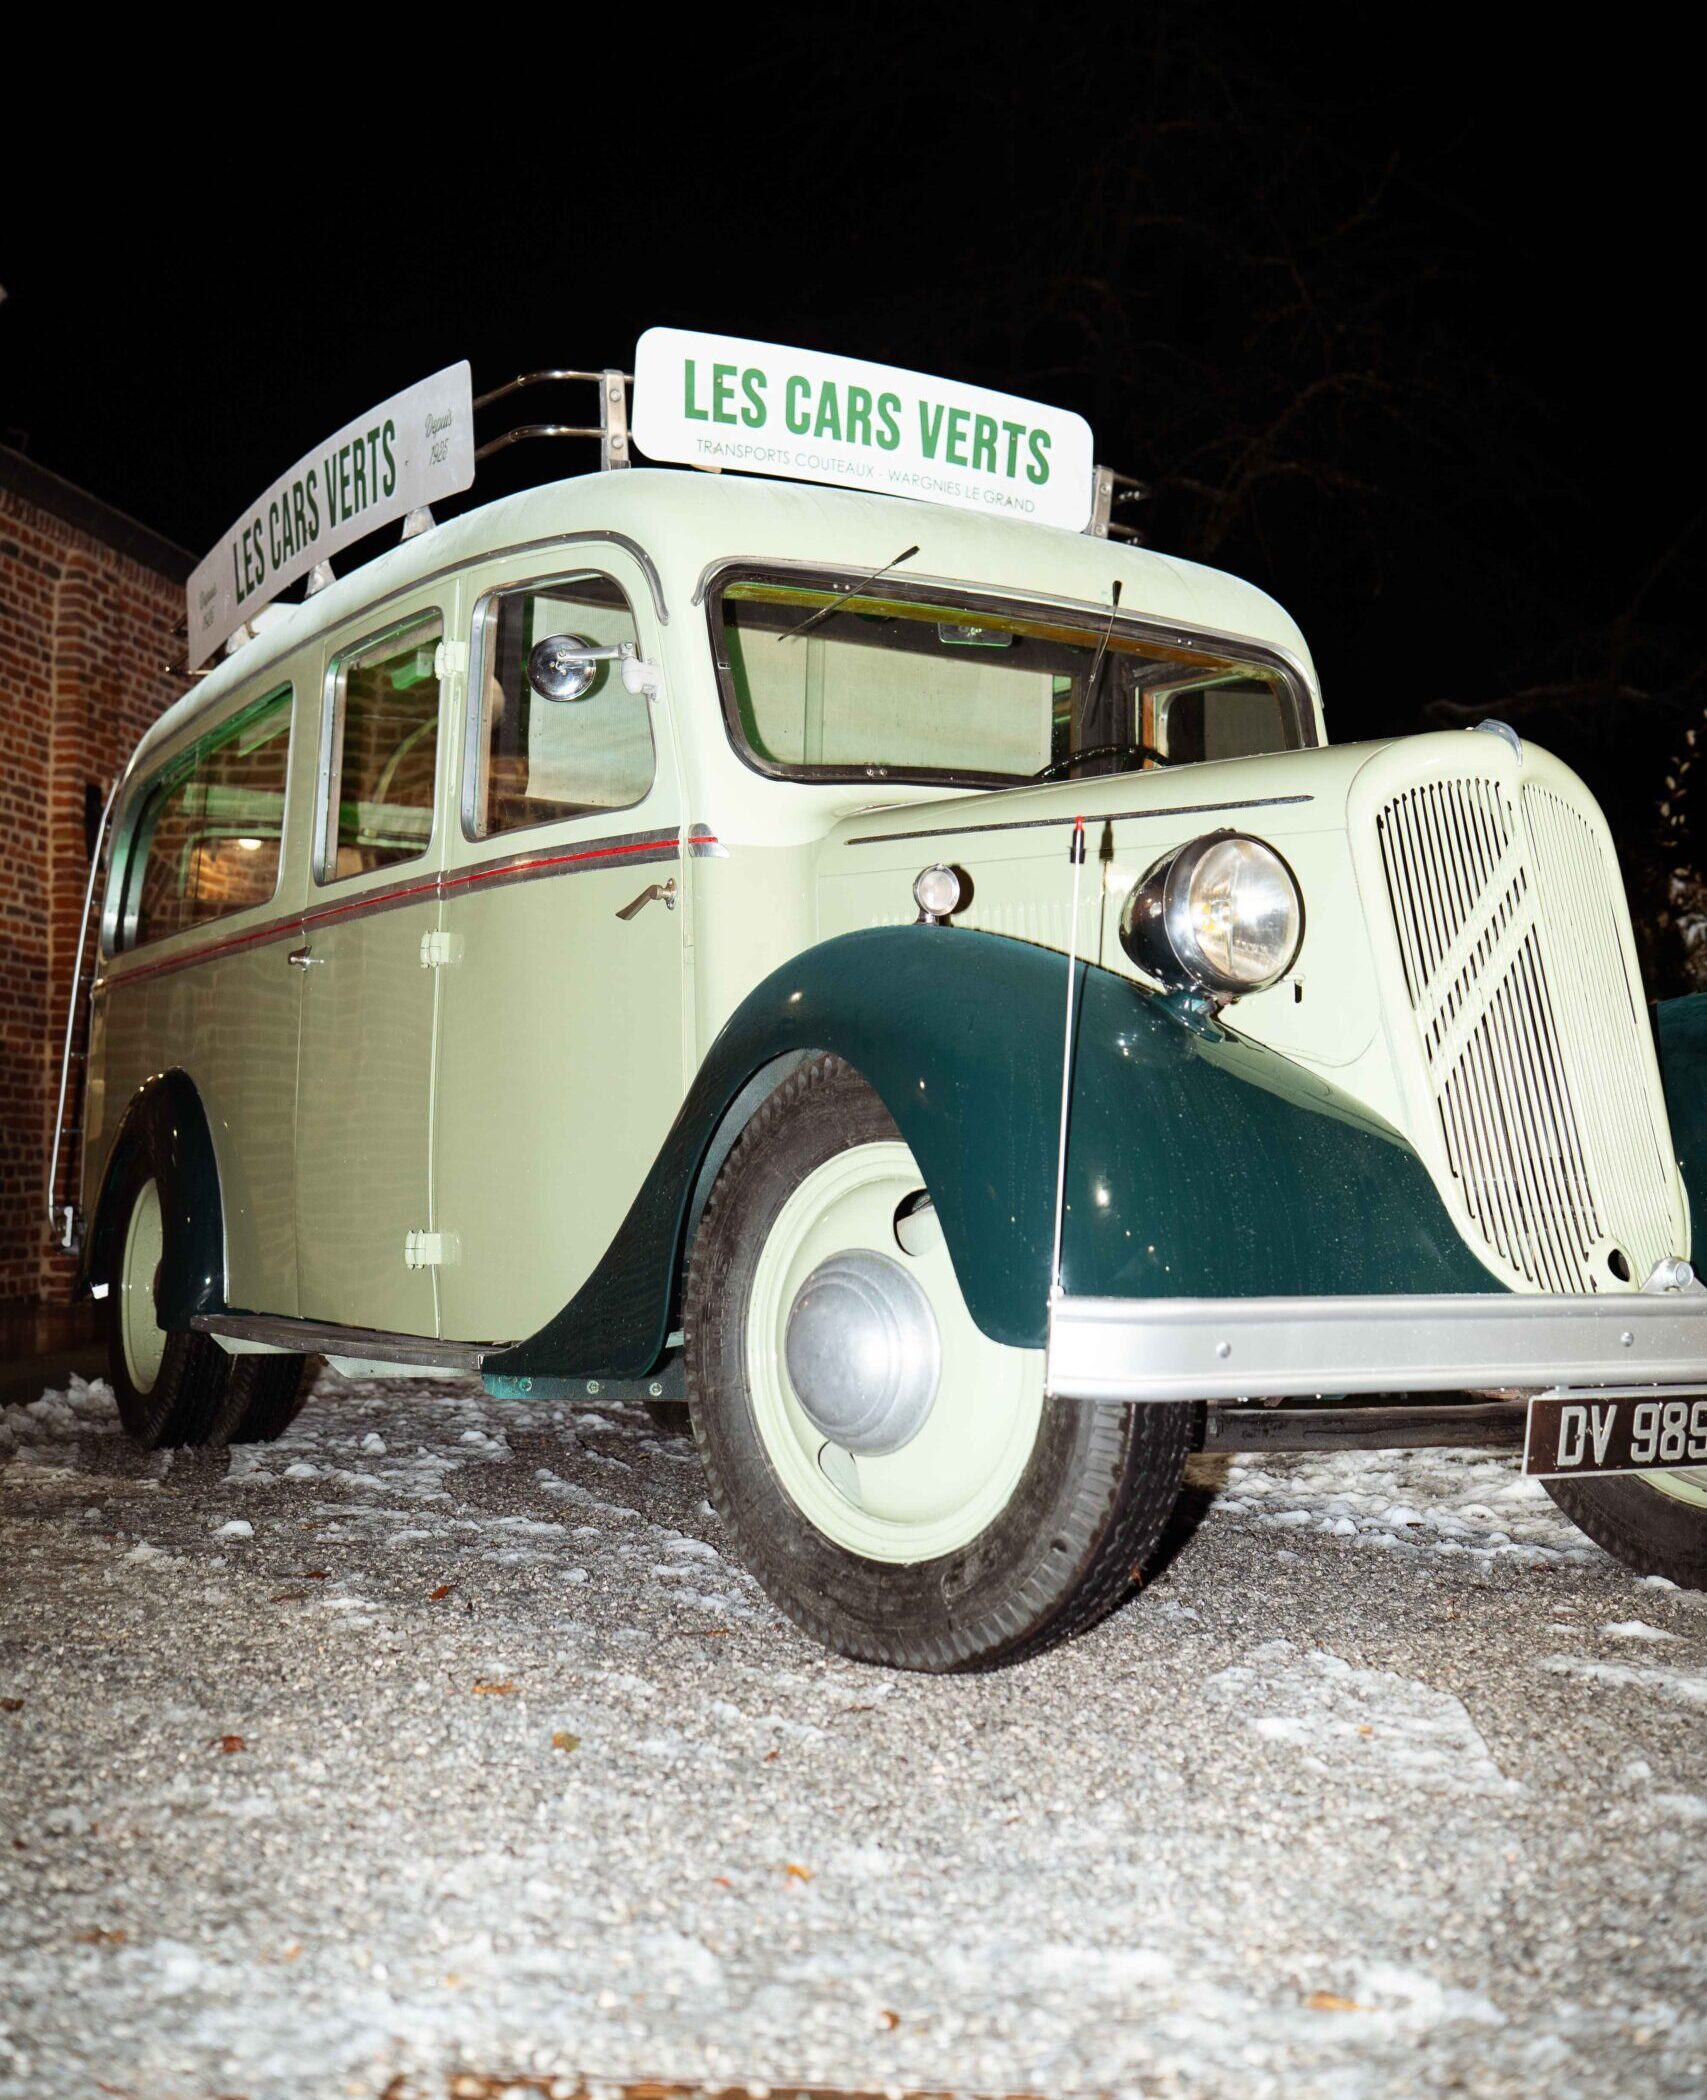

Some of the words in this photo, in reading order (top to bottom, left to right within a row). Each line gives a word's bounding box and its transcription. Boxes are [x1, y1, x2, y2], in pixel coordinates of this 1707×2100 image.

[685, 359, 768, 429] LES
[785, 375, 902, 451] CARS
[919, 400, 1052, 485] VERTS
[233, 518, 265, 606] LES
[269, 469, 320, 571] CARS
[324, 419, 397, 528] VERTS
[697, 439, 790, 465] TRANSPORTS
[795, 452, 875, 478] COUTEAUX
[888, 469, 961, 497] WARGNIES
[965, 487, 979, 501] LE
[983, 489, 1036, 514] GRAND
[1557, 1404, 1618, 1466] DV
